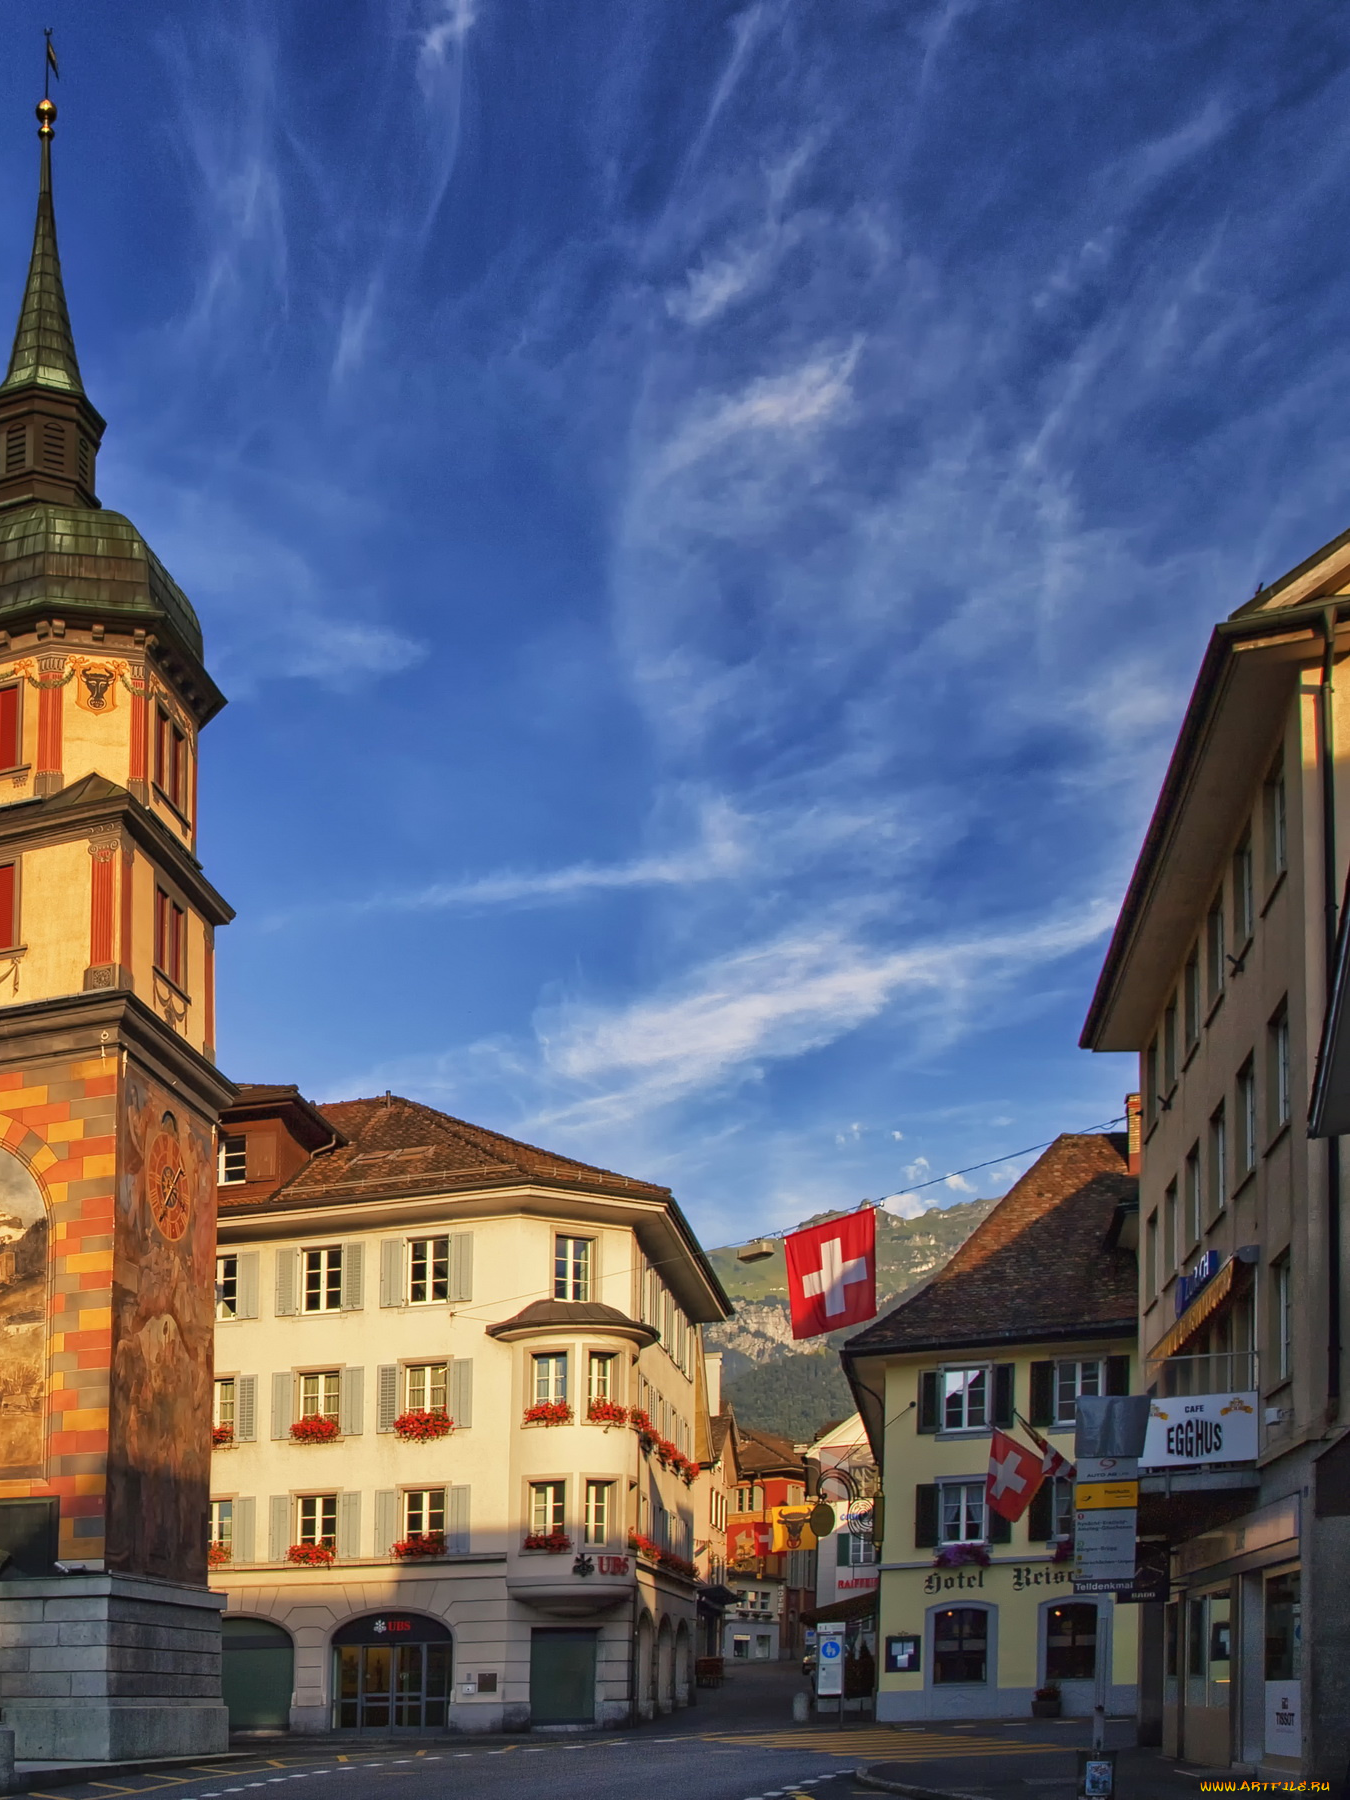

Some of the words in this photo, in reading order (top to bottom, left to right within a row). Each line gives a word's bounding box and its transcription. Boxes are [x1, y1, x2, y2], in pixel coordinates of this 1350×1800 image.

[1184, 1404, 1205, 1413] CAFE
[1167, 1419, 1222, 1458] EGGHUS
[597, 1555, 630, 1576] UBS
[923, 1569, 984, 1595] Hotel
[1075, 1581, 1134, 1591] Telldenkmal
[387, 1620, 411, 1632] UBS
[1275, 1711, 1295, 1727] TISSOT
